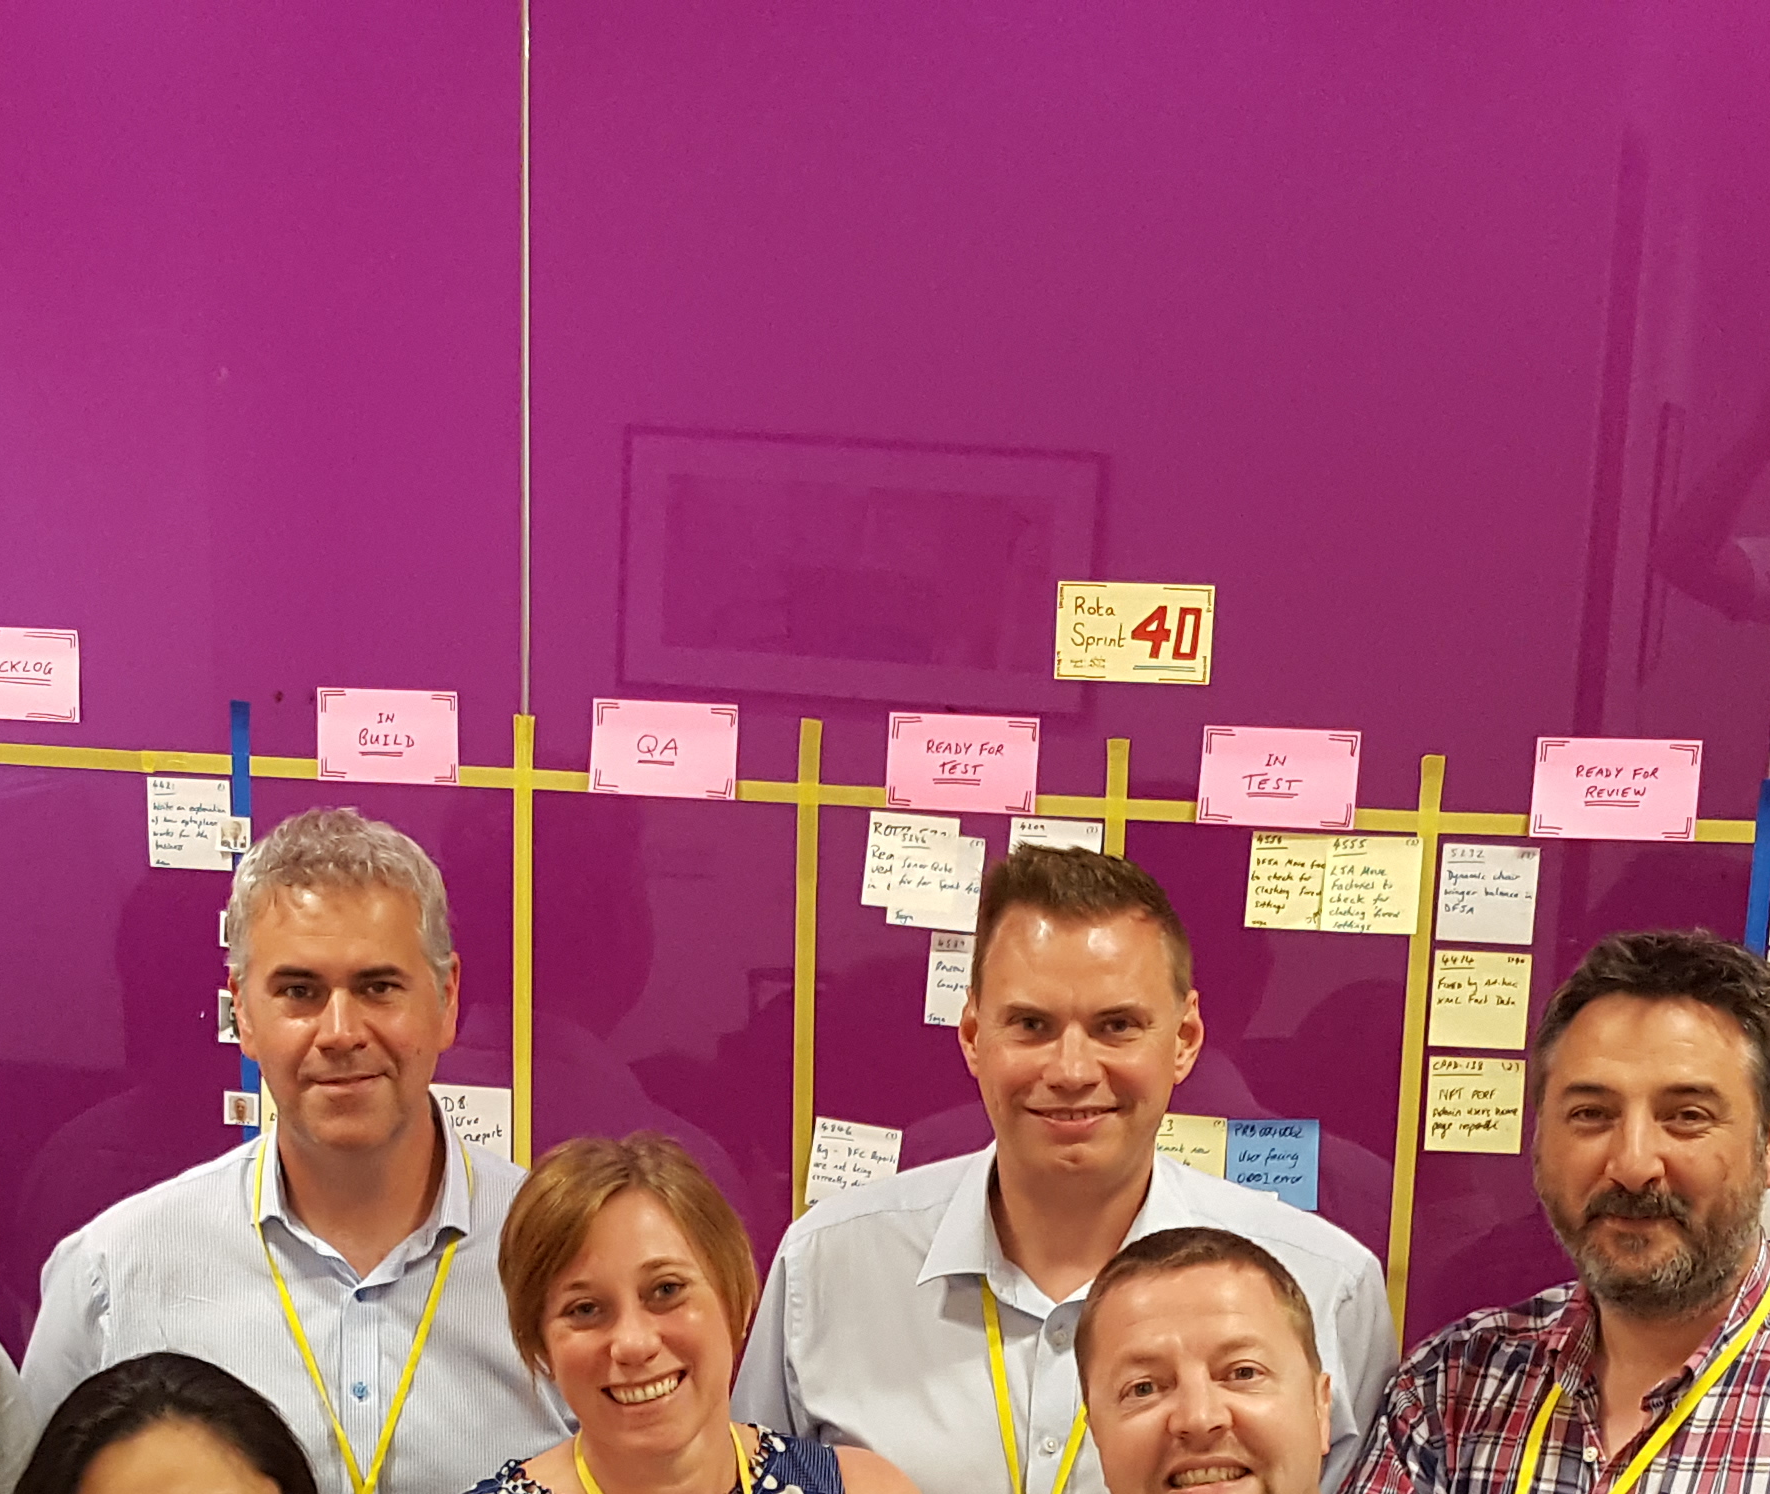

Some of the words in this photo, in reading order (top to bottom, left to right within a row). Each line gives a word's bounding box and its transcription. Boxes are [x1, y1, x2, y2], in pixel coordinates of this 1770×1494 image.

[1074, 596, 1115, 616] Rota
[1131, 605, 1203, 660] 40
[1071, 622, 1127, 652] Sprint
[377, 712, 395, 724] IN
[358, 727, 416, 748] BUILD
[637, 734, 678, 758] QA
[926, 739, 973, 756] READY
[978, 741, 1004, 756] FOR
[939, 760, 984, 775] TEST
[1265, 753, 1286, 766] IN
[1575, 764, 1624, 780] READY
[1632, 767, 1658, 780] FOR
[1242, 773, 1303, 790] TEST
[1585, 785, 1647, 799] REVIEW
